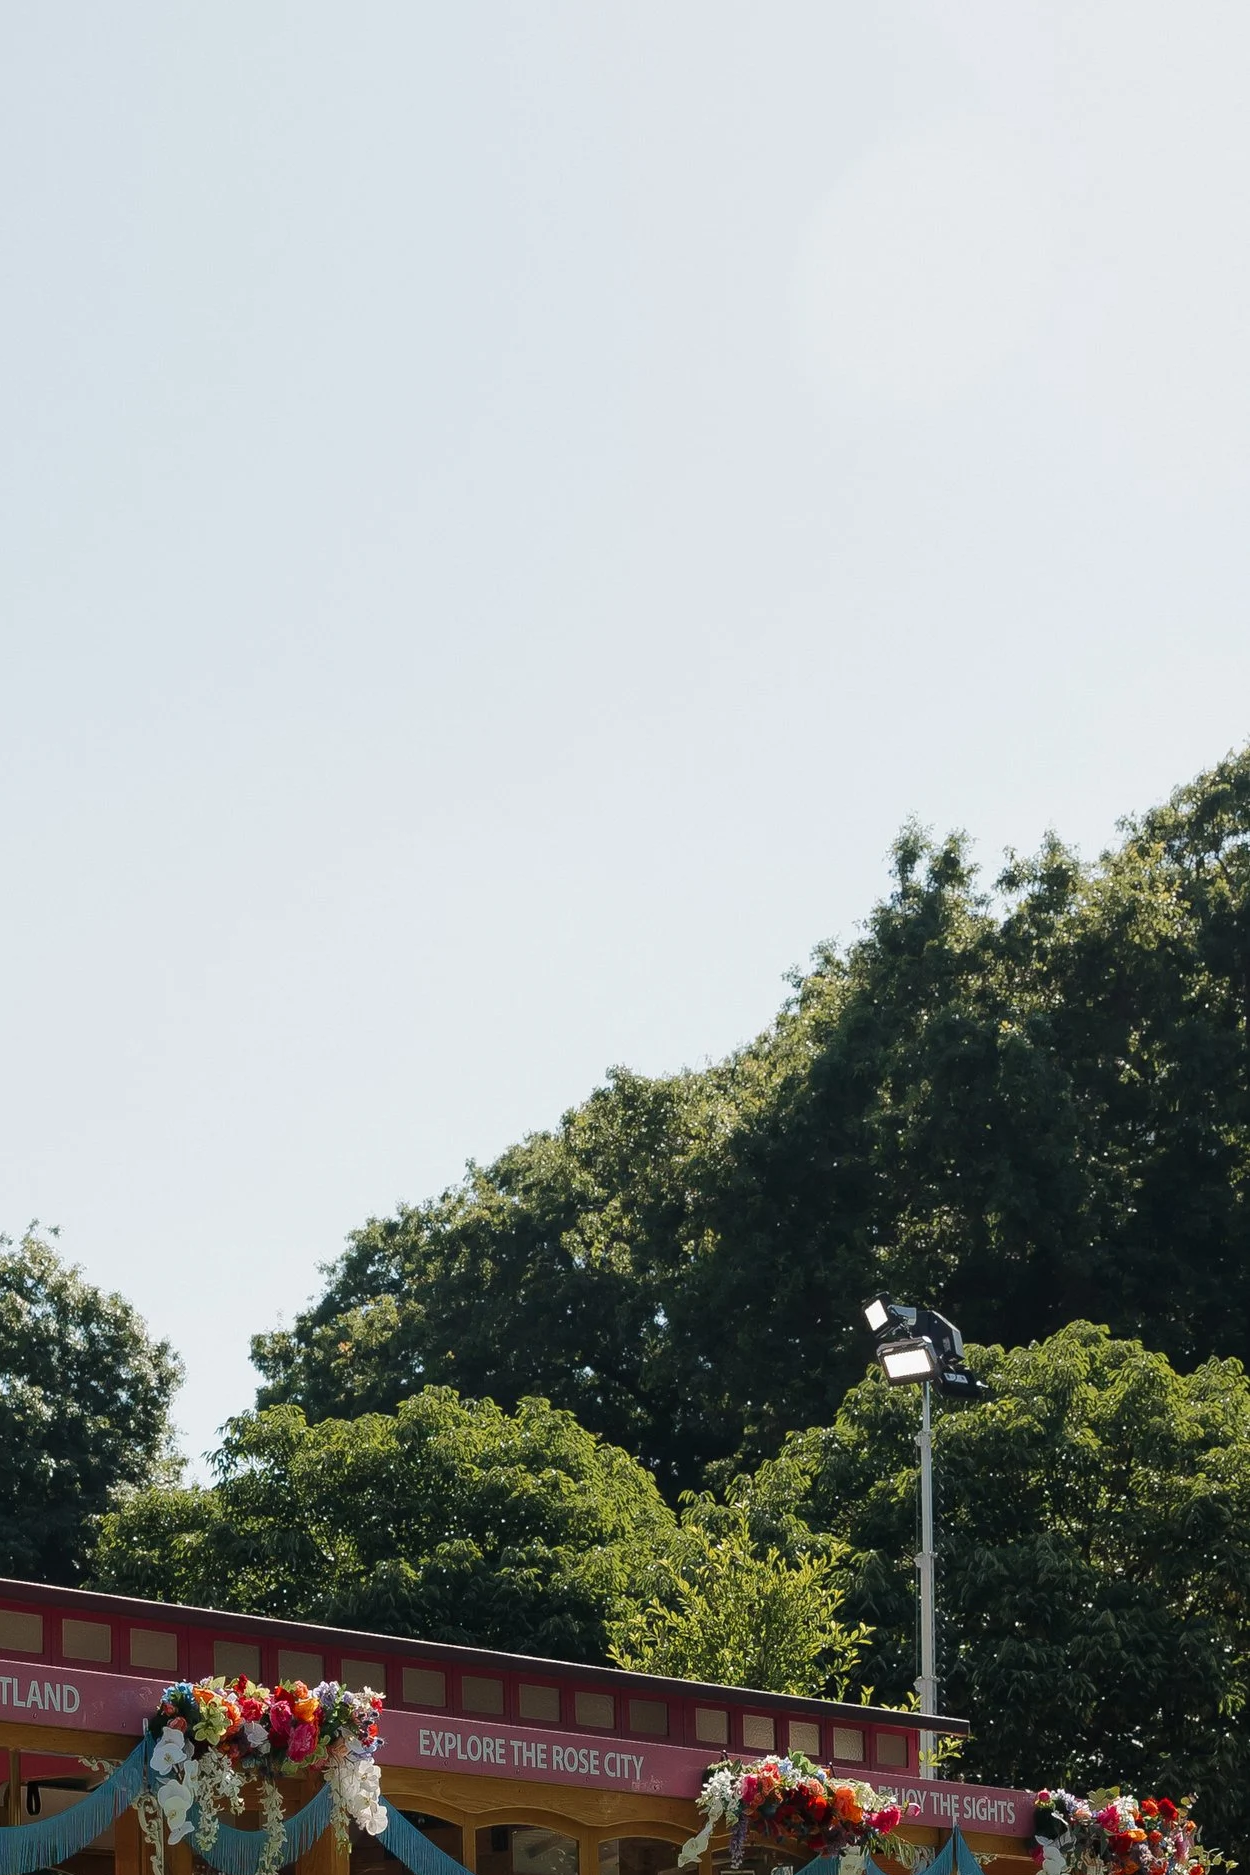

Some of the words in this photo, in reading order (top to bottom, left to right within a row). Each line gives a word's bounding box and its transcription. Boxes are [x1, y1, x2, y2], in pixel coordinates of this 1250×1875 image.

[419, 1729, 506, 1764] EXPLORE
[510, 1740, 548, 1769] THE
[552, 1745, 600, 1775] ROSE
[603, 1752, 645, 1781] CITY
[930, 1791, 960, 1818] THE
[963, 1796, 1016, 1825] SIGHTS
